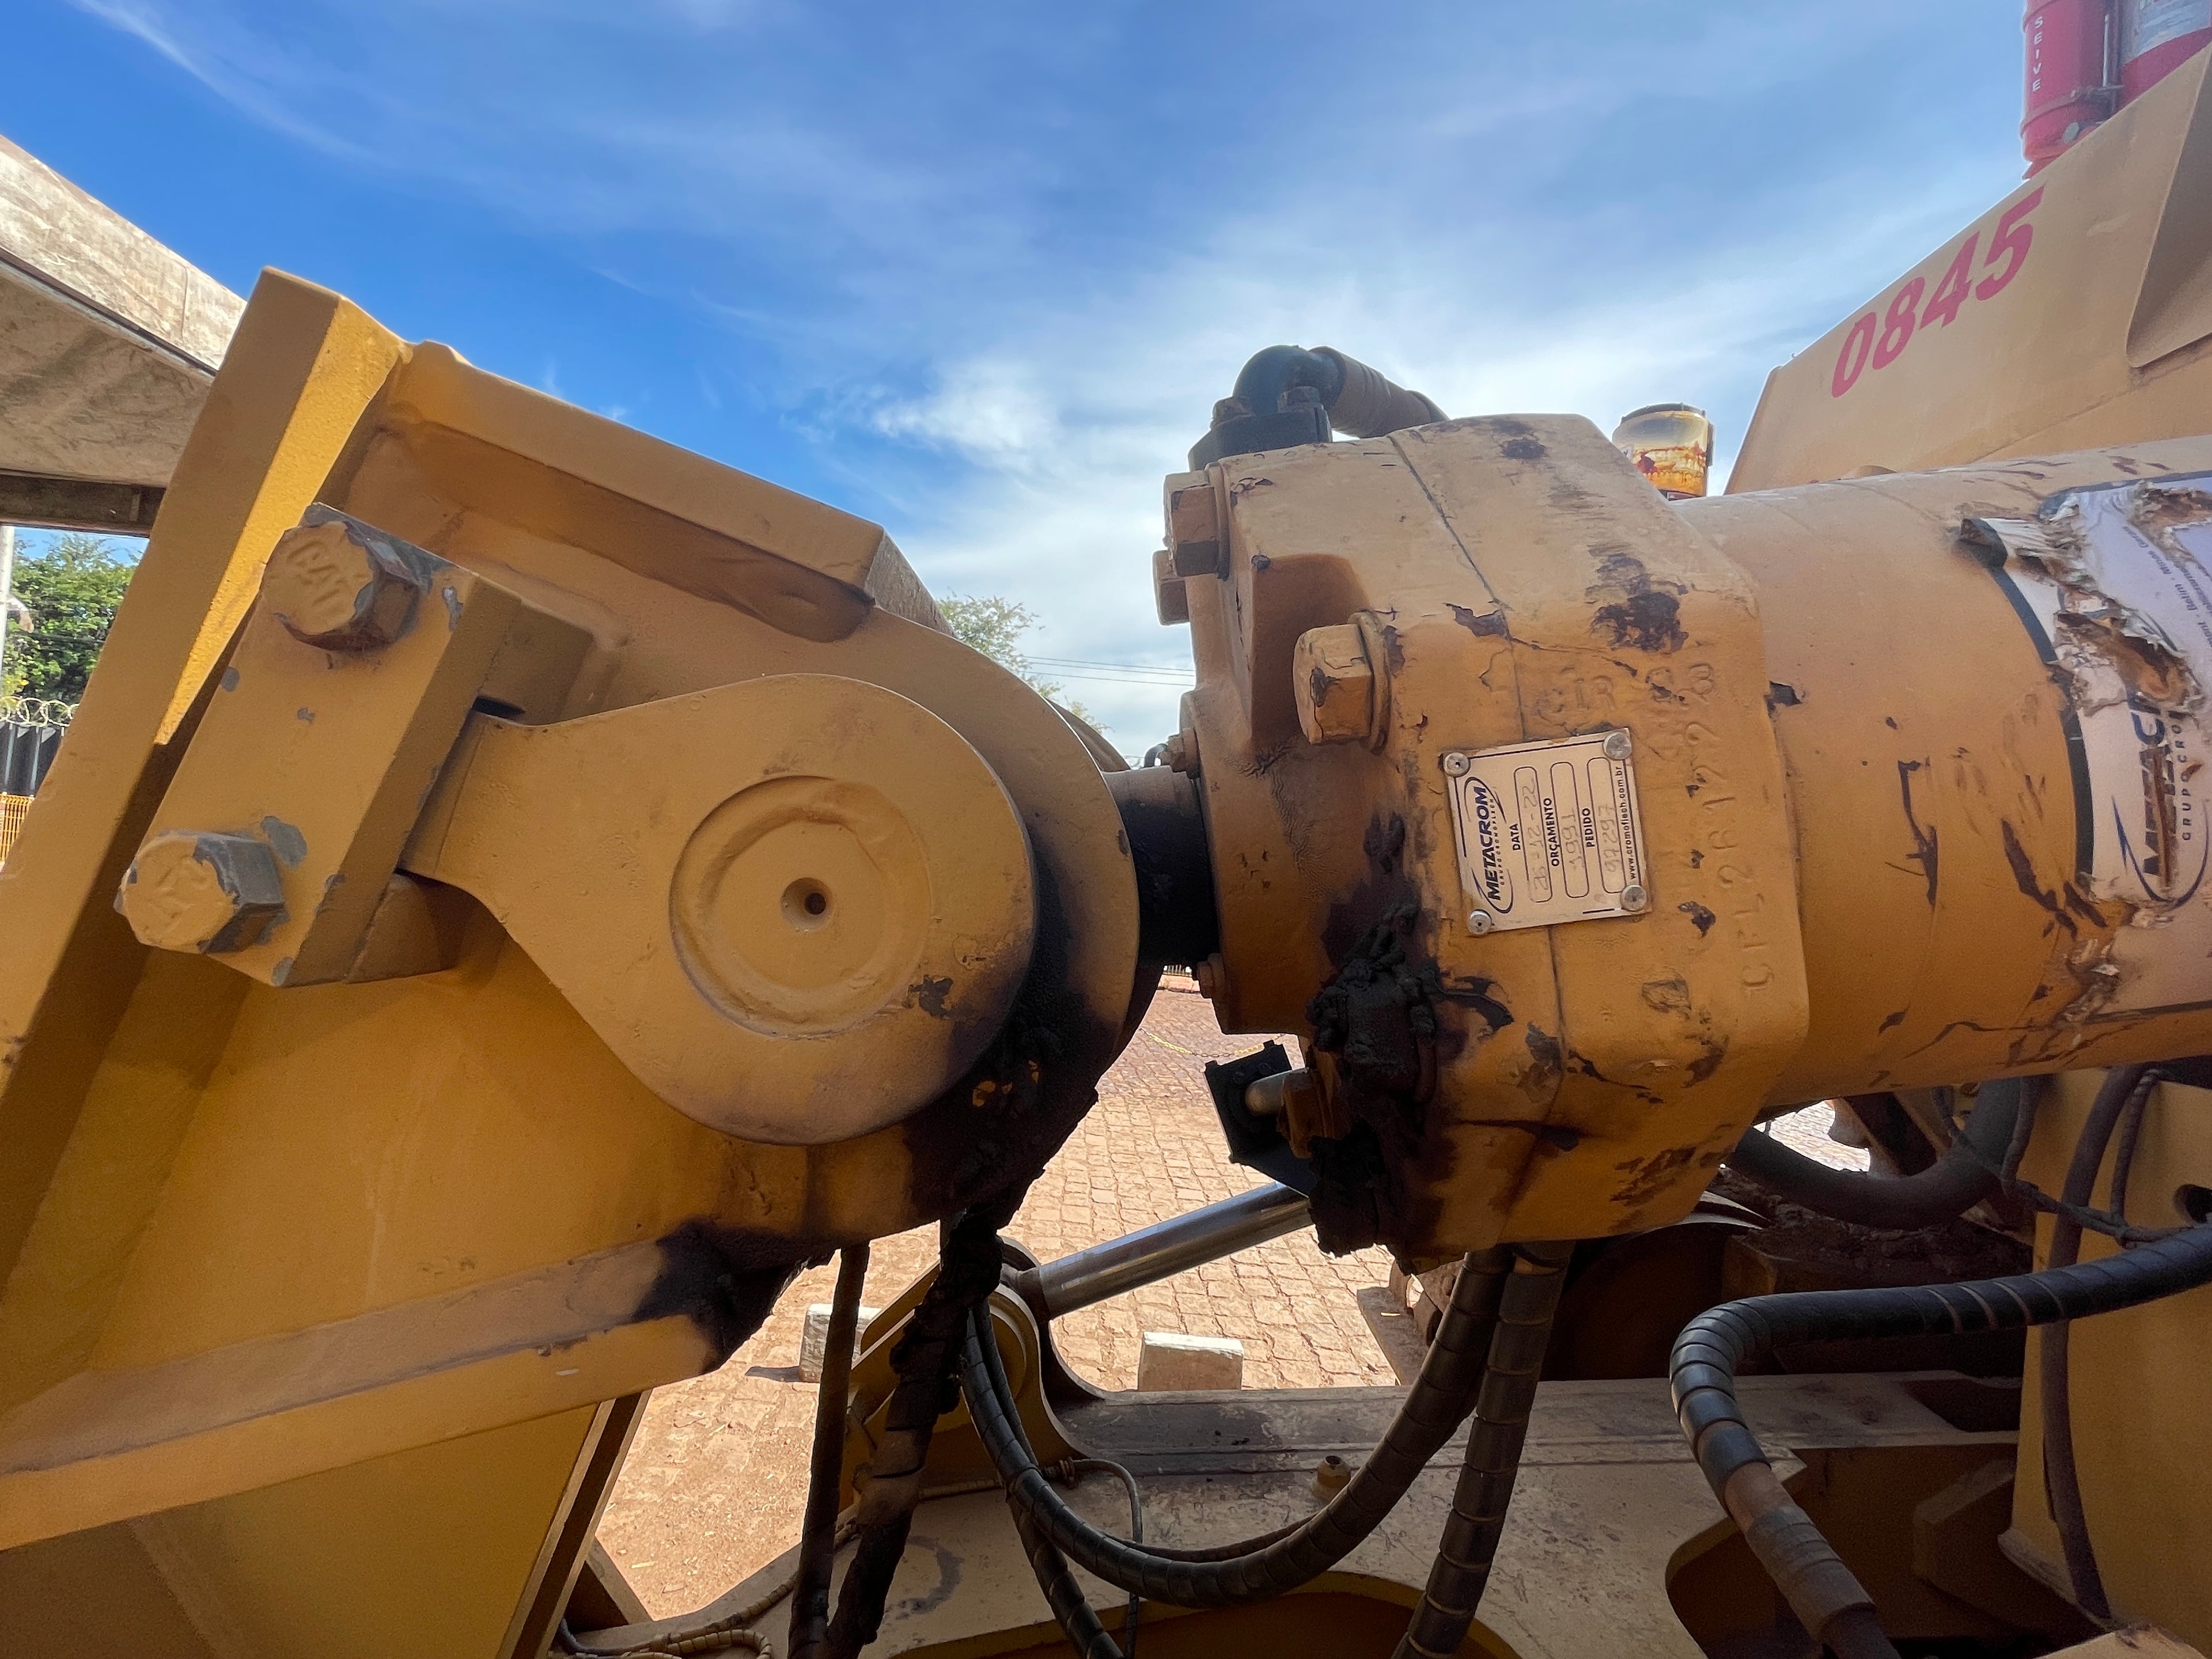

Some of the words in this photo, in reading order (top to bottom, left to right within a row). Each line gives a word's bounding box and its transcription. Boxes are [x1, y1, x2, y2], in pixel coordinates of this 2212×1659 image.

[1831, 183, 2046, 398] 0845
[1473, 786, 1501, 901] METACROM
[1509, 823, 1521, 851] DATA
[1543, 798, 1560, 867] ORÇAMENTO
[1582, 808, 1596, 848] PEDIDO
